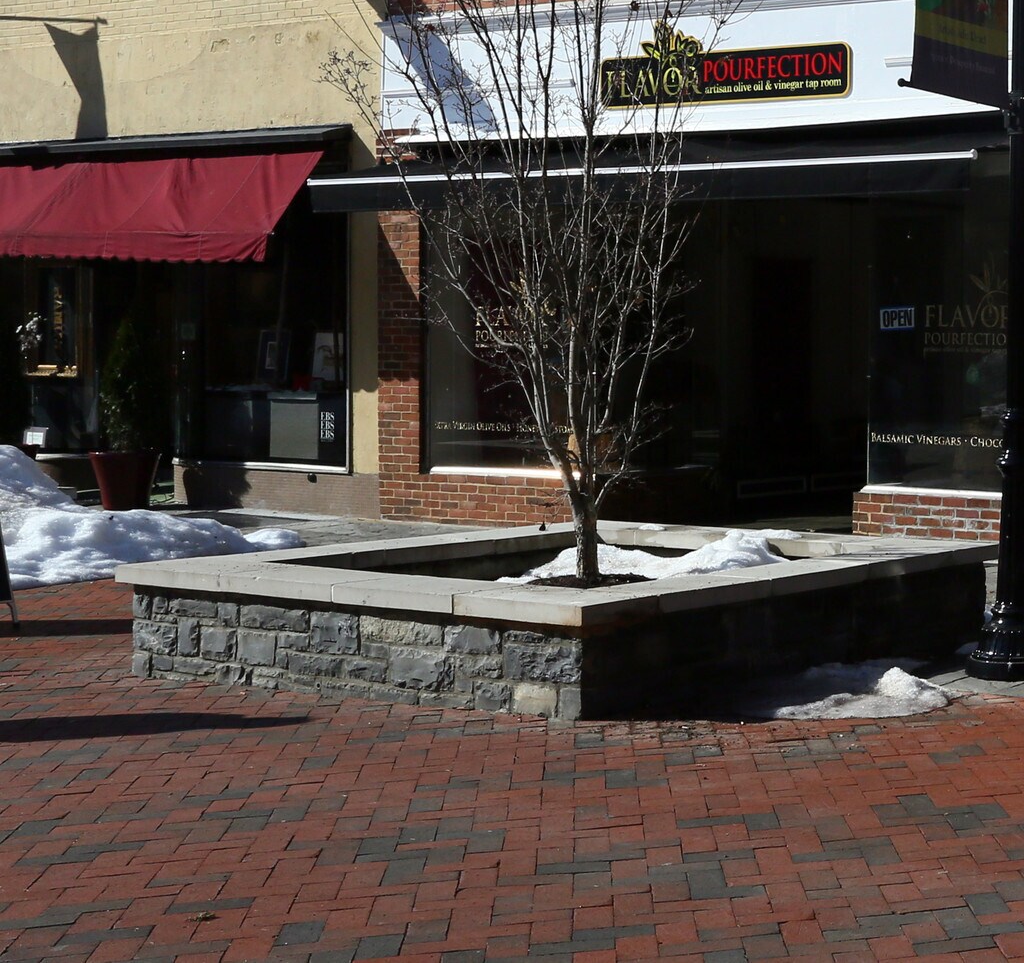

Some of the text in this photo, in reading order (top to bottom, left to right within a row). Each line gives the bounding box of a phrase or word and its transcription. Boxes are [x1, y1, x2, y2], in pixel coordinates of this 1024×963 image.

[703, 51, 843, 82] POURFECTION
[705, 78, 842, 94] artisan olive oil & vinegar tap room
[883, 309, 912, 327] OPEN
[320, 411, 335, 420] EBS
[320, 420, 335, 429] EBS
[320, 429, 335, 439] EBS
[871, 432, 914, 444] BALSAMIC
[916, 434, 961, 446] VINEGARS
